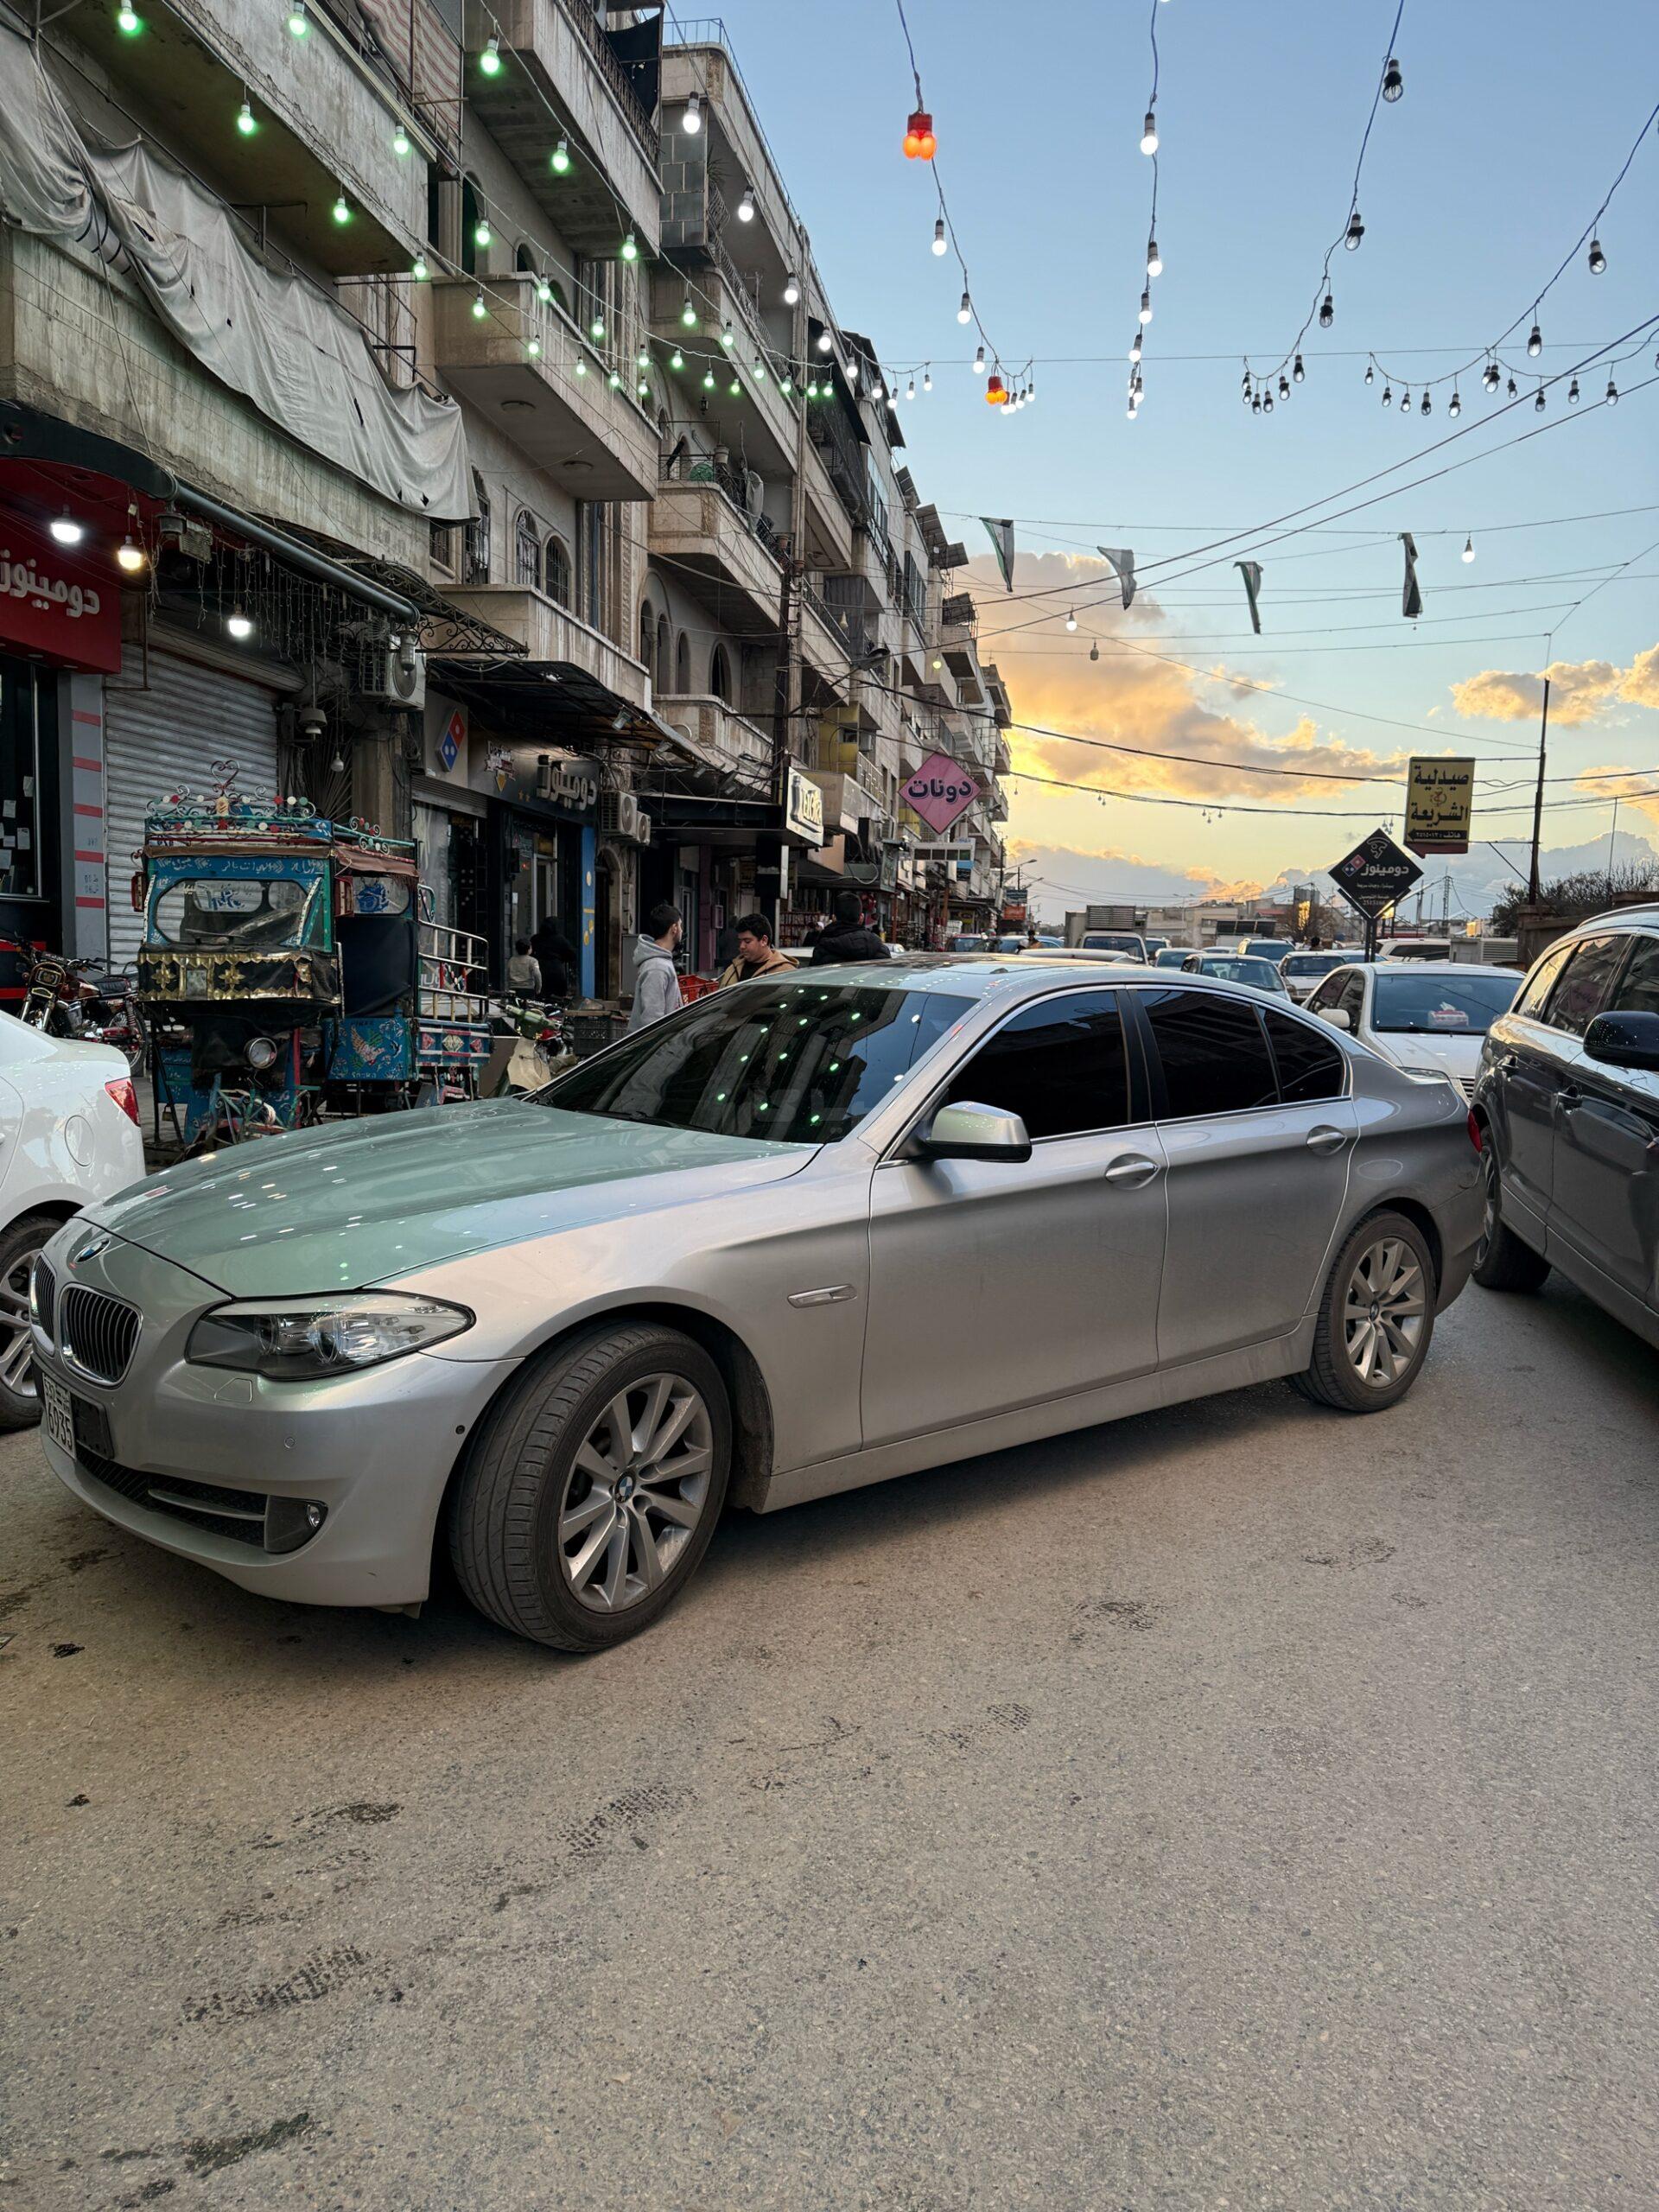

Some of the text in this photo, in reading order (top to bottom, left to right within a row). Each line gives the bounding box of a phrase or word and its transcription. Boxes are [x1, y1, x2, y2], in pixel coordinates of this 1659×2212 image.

[537, 754, 597, 811] دومينوز
[908, 778, 972, 804] دونات
[1414, 765, 1469, 791] صيدلية
[1411, 802, 1469, 828] الشريعة
[1360, 863, 1409, 877] دومينوز
[48, 1402, 73, 1451] 6935
